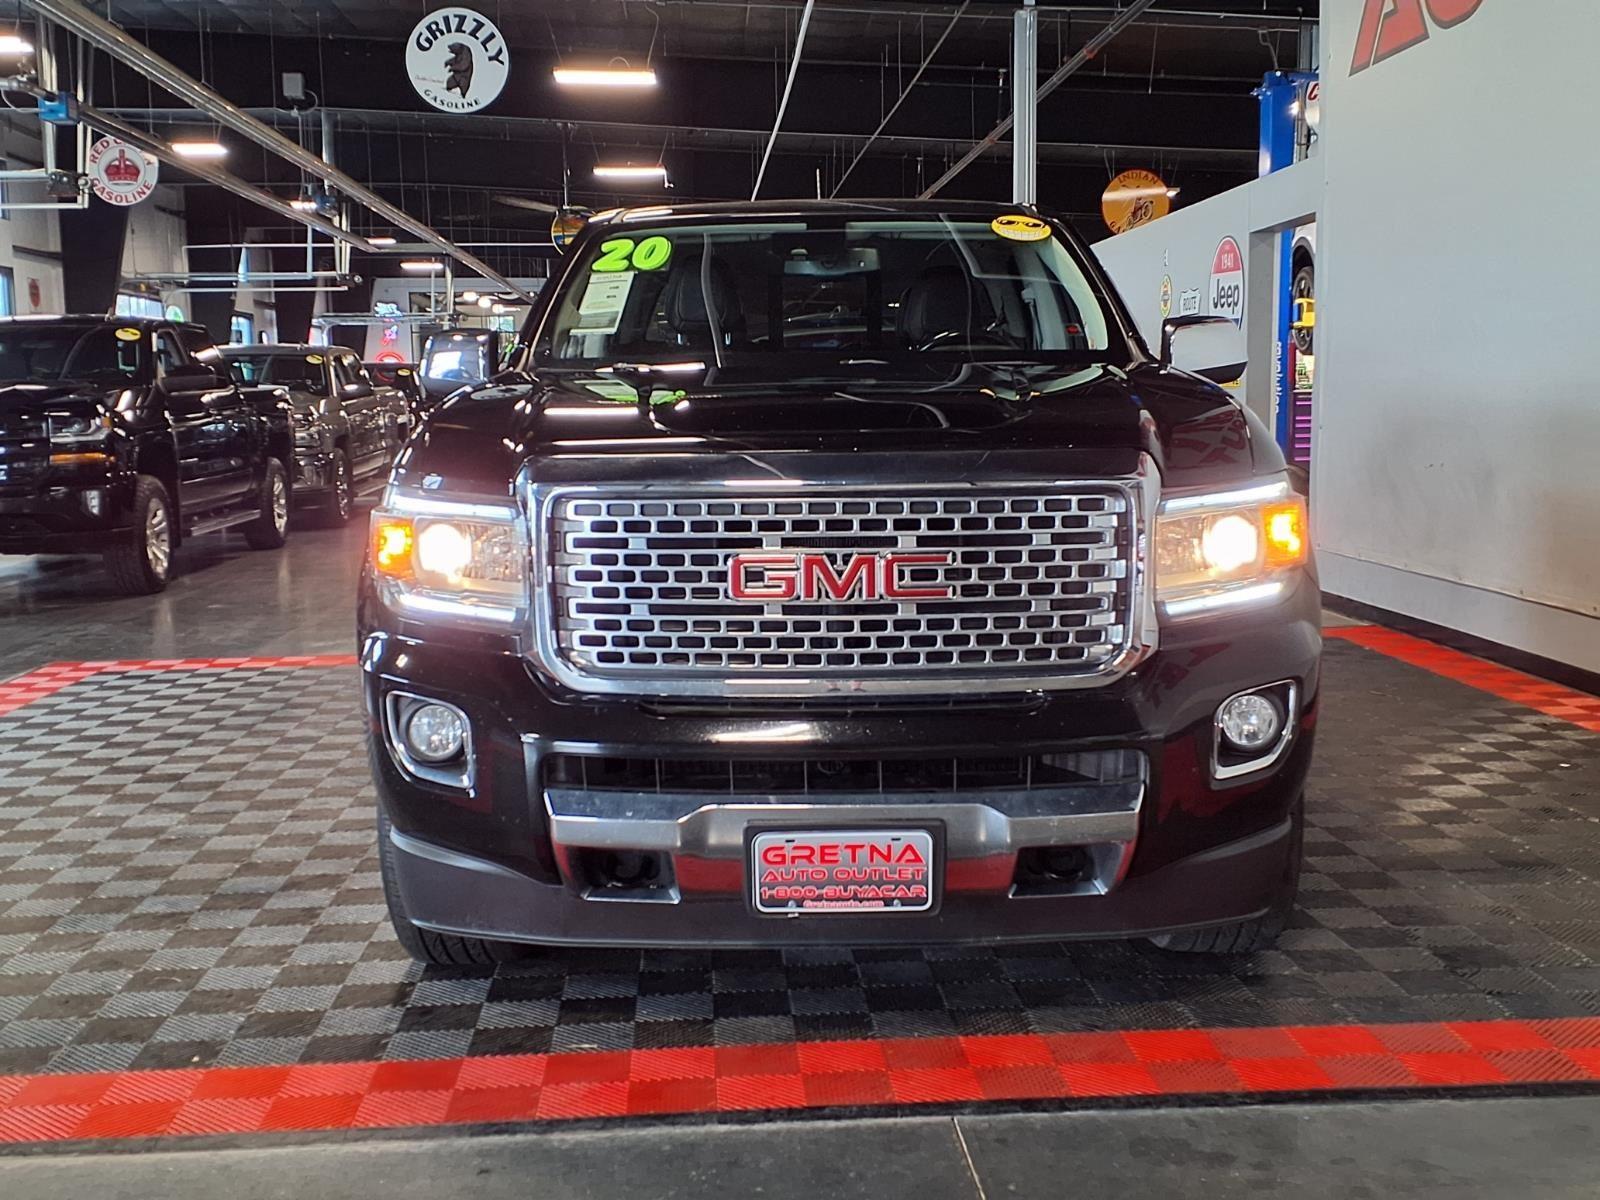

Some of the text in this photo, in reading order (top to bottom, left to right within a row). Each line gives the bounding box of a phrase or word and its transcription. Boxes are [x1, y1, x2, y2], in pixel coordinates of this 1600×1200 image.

[416, 14, 504, 66] GRIZZLY
[424, 89, 481, 109] GASOLINE
[90, 139, 110, 164] RED
[92, 177, 153, 204] GASOLINE
[1117, 171, 1159, 185] INDIAN
[591, 235, 672, 272] 20
[1212, 278, 1240, 315] Jeep
[728, 552, 954, 601] GMC
[761, 843, 926, 866] GRETNA
[761, 866, 927, 882] AUTO OUTLET
